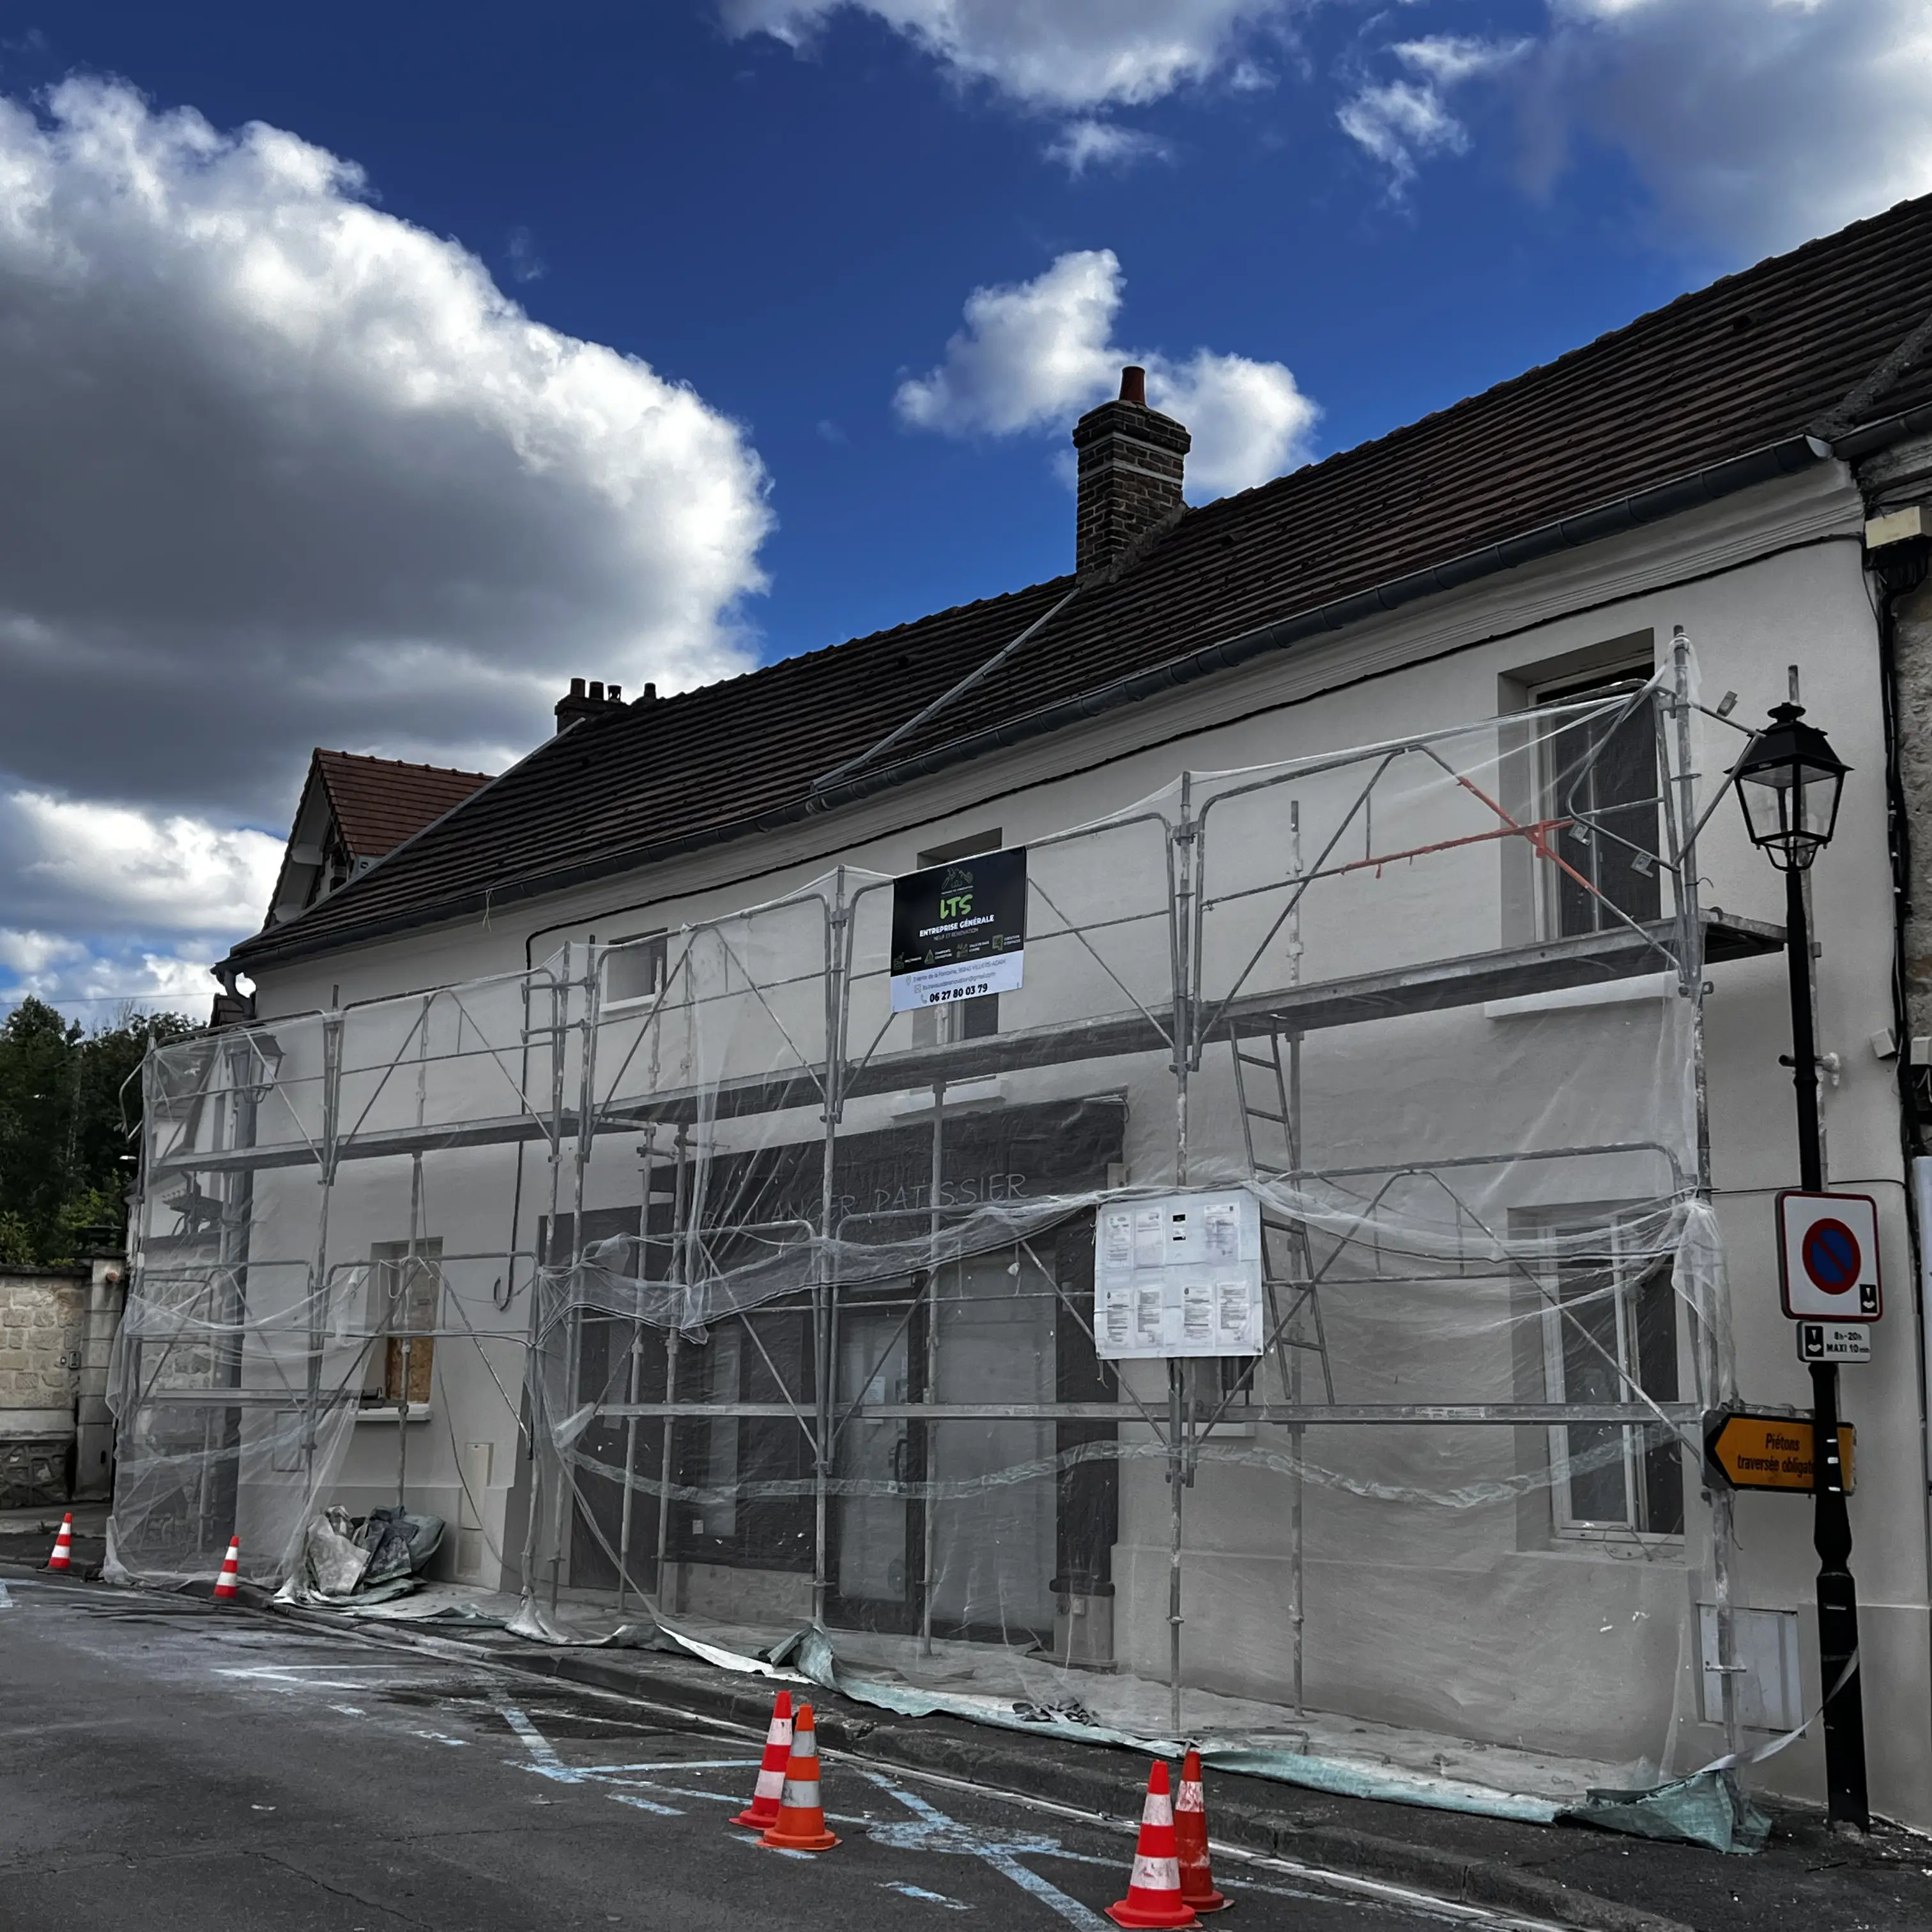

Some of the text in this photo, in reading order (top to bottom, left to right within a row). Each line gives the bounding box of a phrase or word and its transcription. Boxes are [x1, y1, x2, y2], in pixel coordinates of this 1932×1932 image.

[940, 894, 973, 919] LTS
[919, 914, 995, 938] ENTREPRISE GÉNÉRALE
[930, 983, 988, 1002] 06 27 80 03 79
[874, 1173, 1030, 1213] PATSSIER
[1827, 1343, 1847, 1353] MAXI
[1765, 1432, 1800, 1452] Piétons
[1737, 1453, 1779, 1472] traversée
